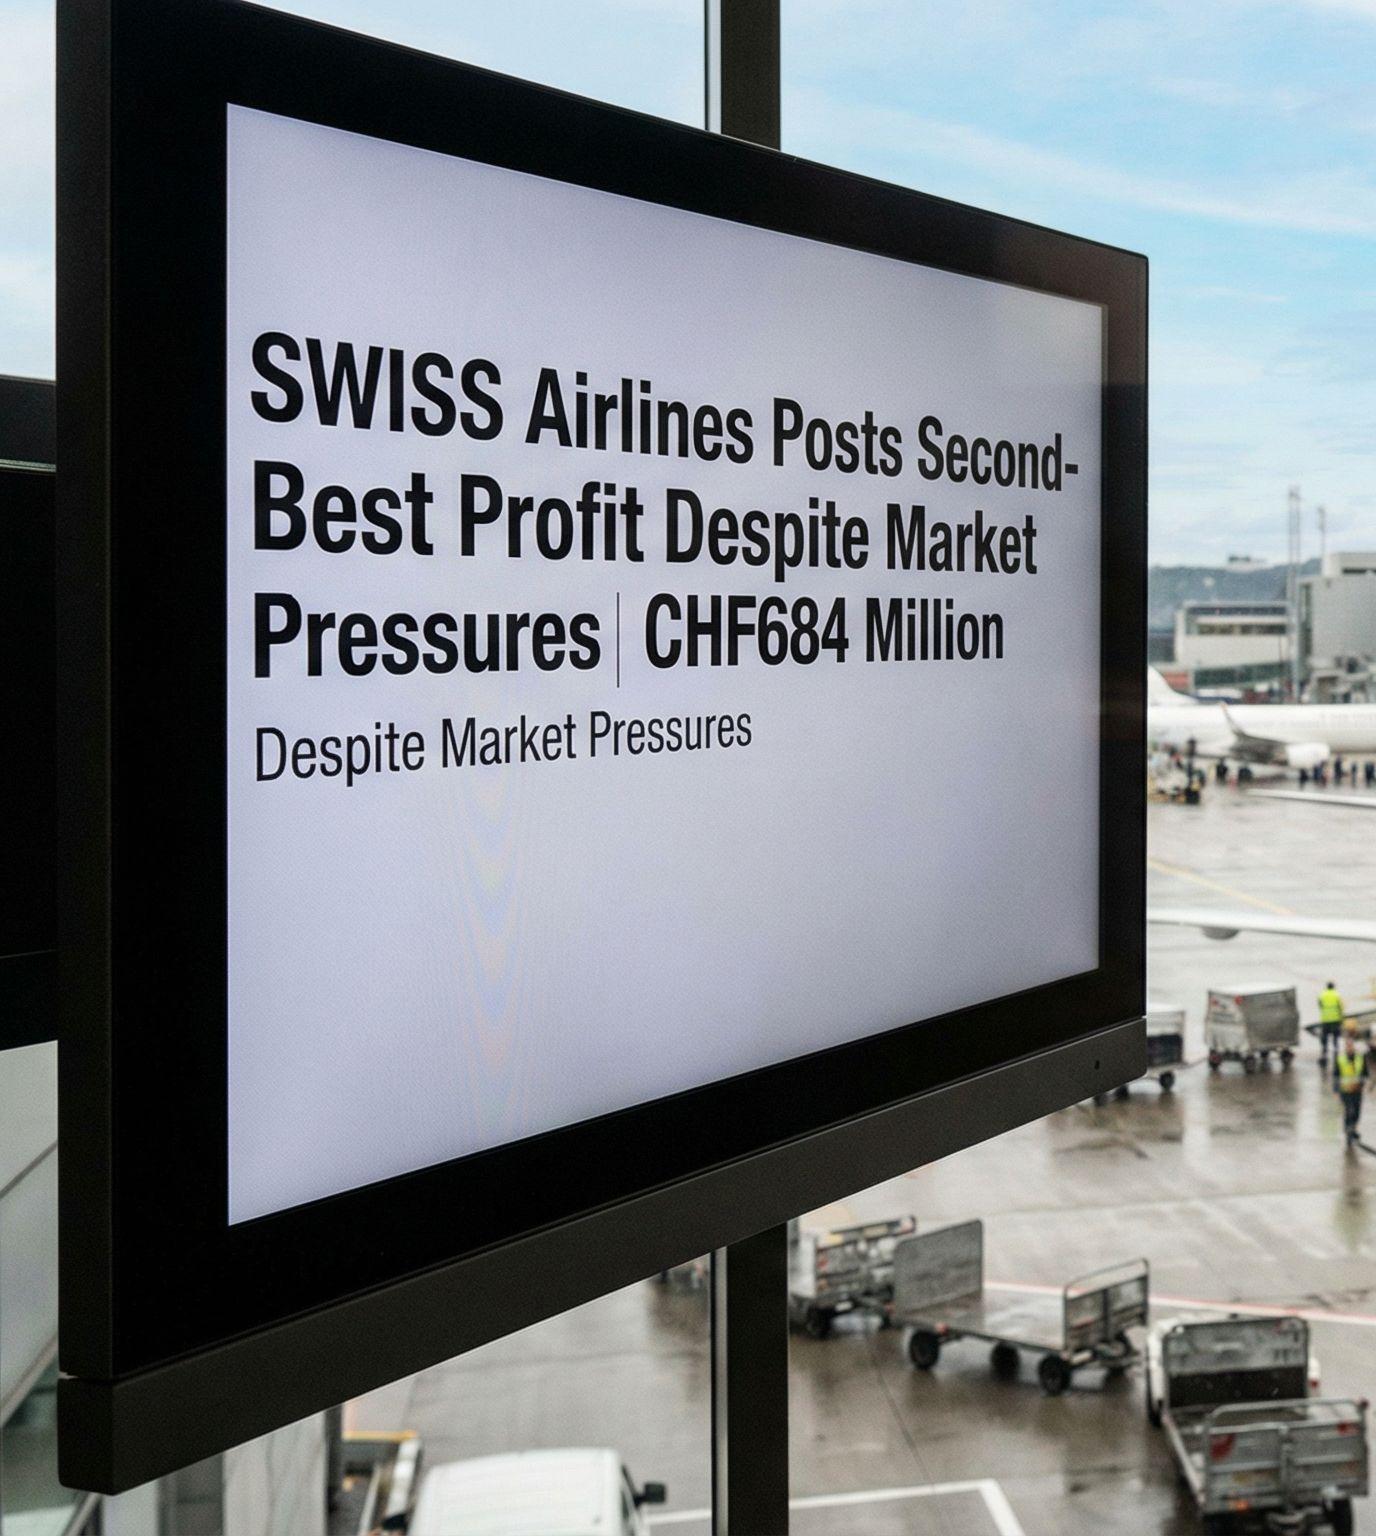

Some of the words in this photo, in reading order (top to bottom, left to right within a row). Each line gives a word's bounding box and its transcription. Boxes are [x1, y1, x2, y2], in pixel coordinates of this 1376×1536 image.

[249, 330, 505, 442] SWISS
[524, 366, 755, 465] Airlines
[772, 397, 904, 478] Posts
[916, 415, 1080, 492] Second-
[252, 458, 435, 557] Best
[459, 472, 646, 563] Profit
[664, 487, 871, 583] Despite
[885, 502, 1038, 576] Market
[253, 592, 602, 679] Pressures
[645, 592, 851, 669] CHF684
[864, 597, 1004, 663] Million
[255, 721, 426, 788] Despite
[441, 714, 578, 768] Market
[589, 710, 753, 758] Pressures
